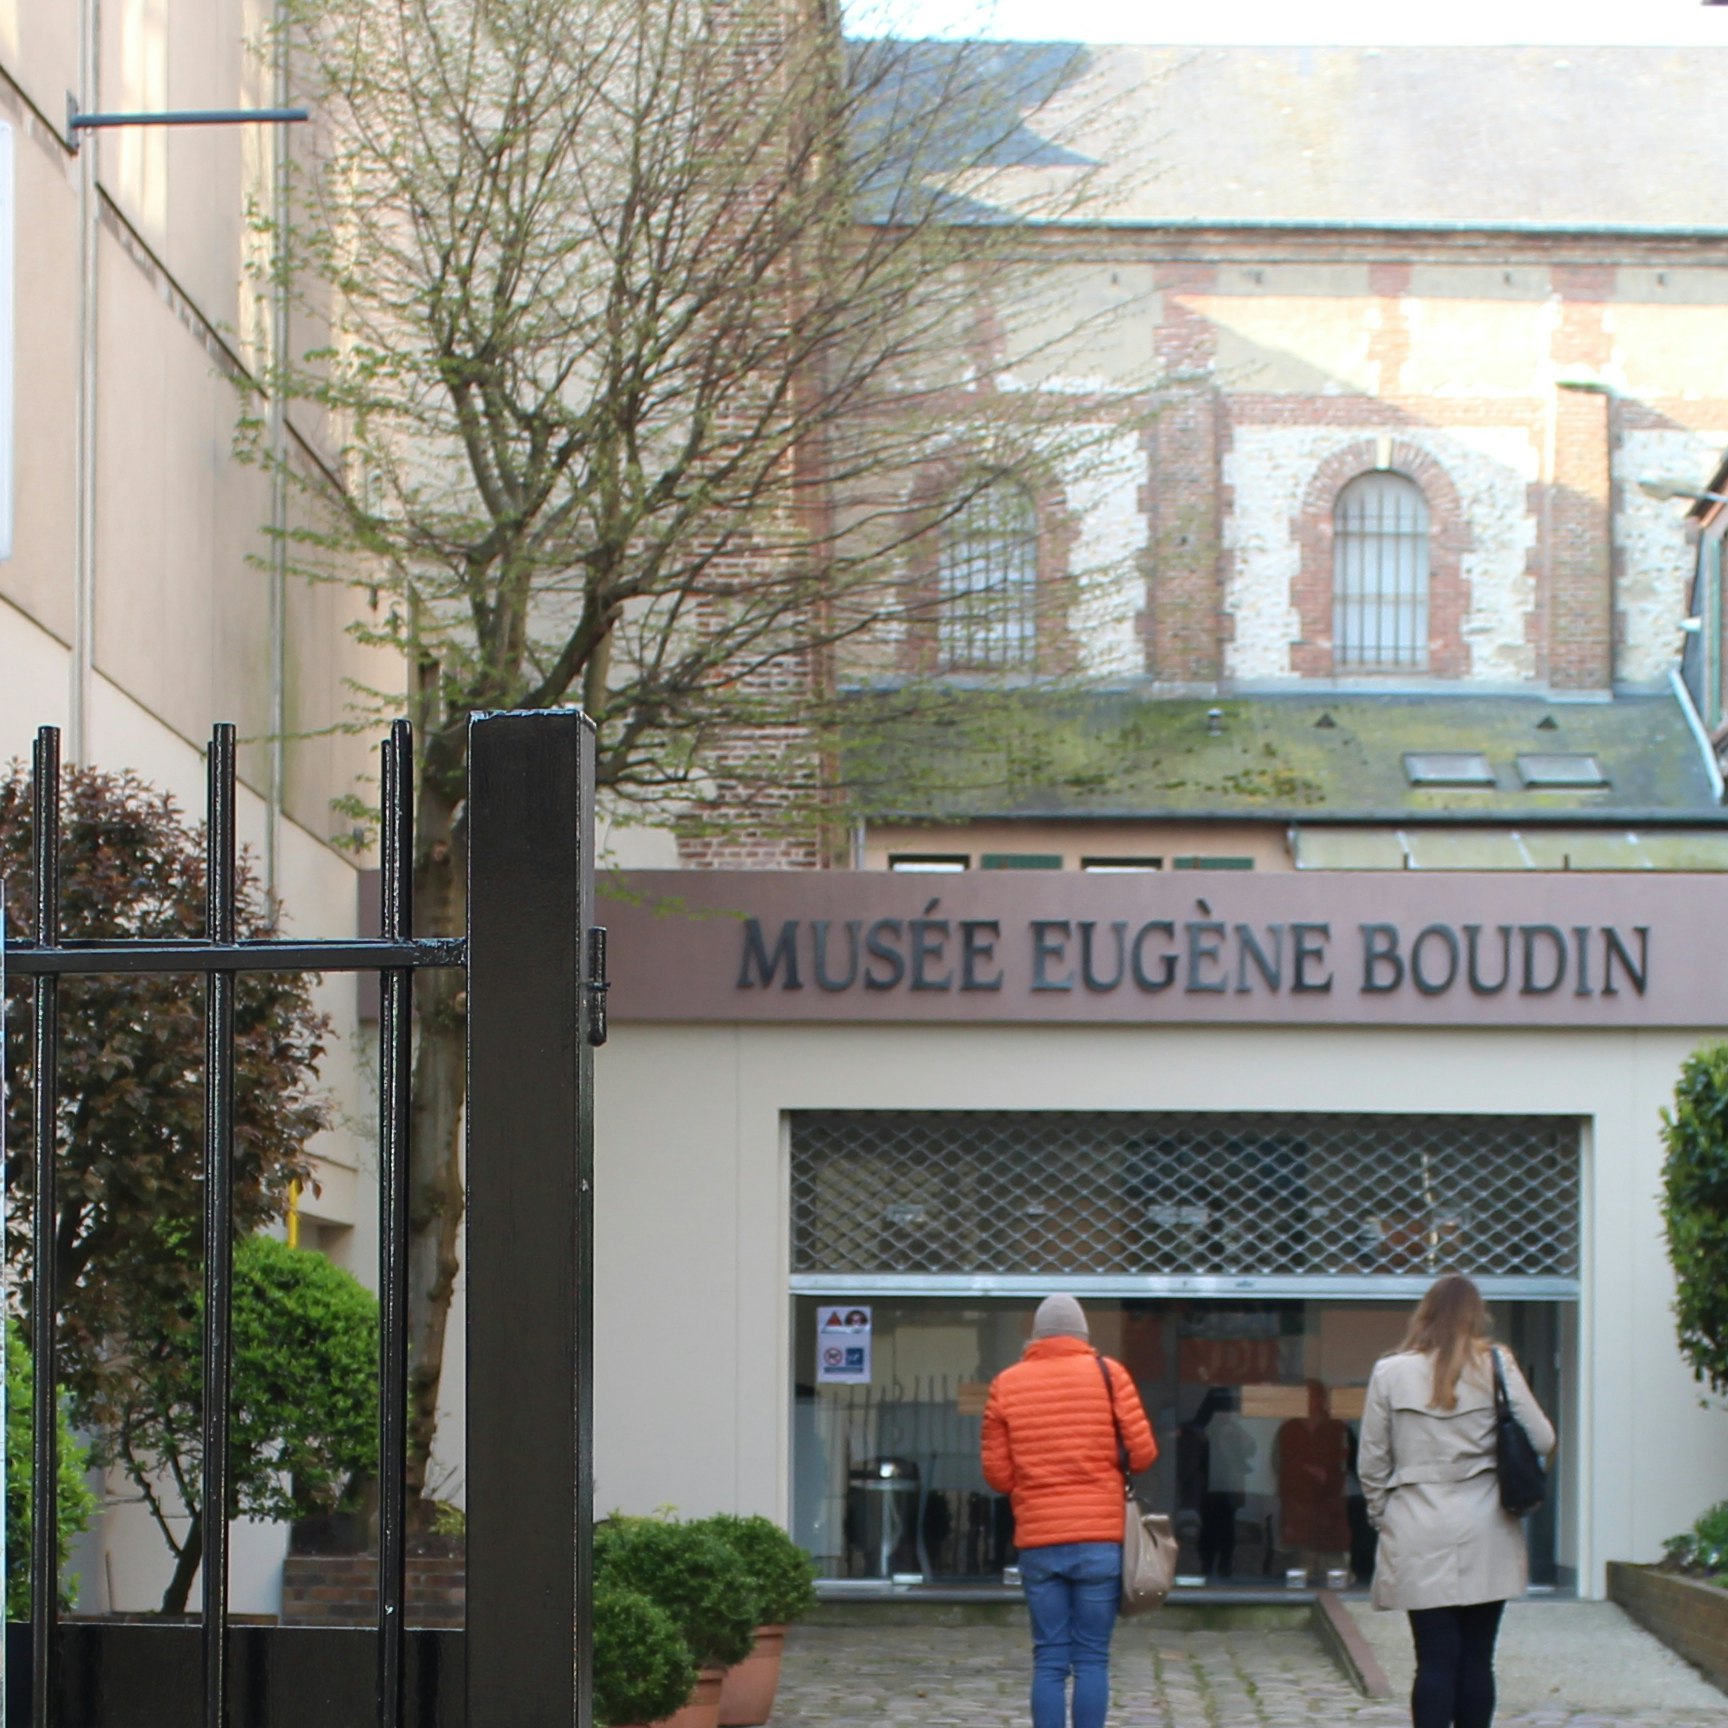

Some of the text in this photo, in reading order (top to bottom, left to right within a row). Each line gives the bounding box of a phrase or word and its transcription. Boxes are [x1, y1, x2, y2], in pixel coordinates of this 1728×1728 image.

[736, 899, 1652, 998] MUSÉE EUGÈNE BOUDIN
